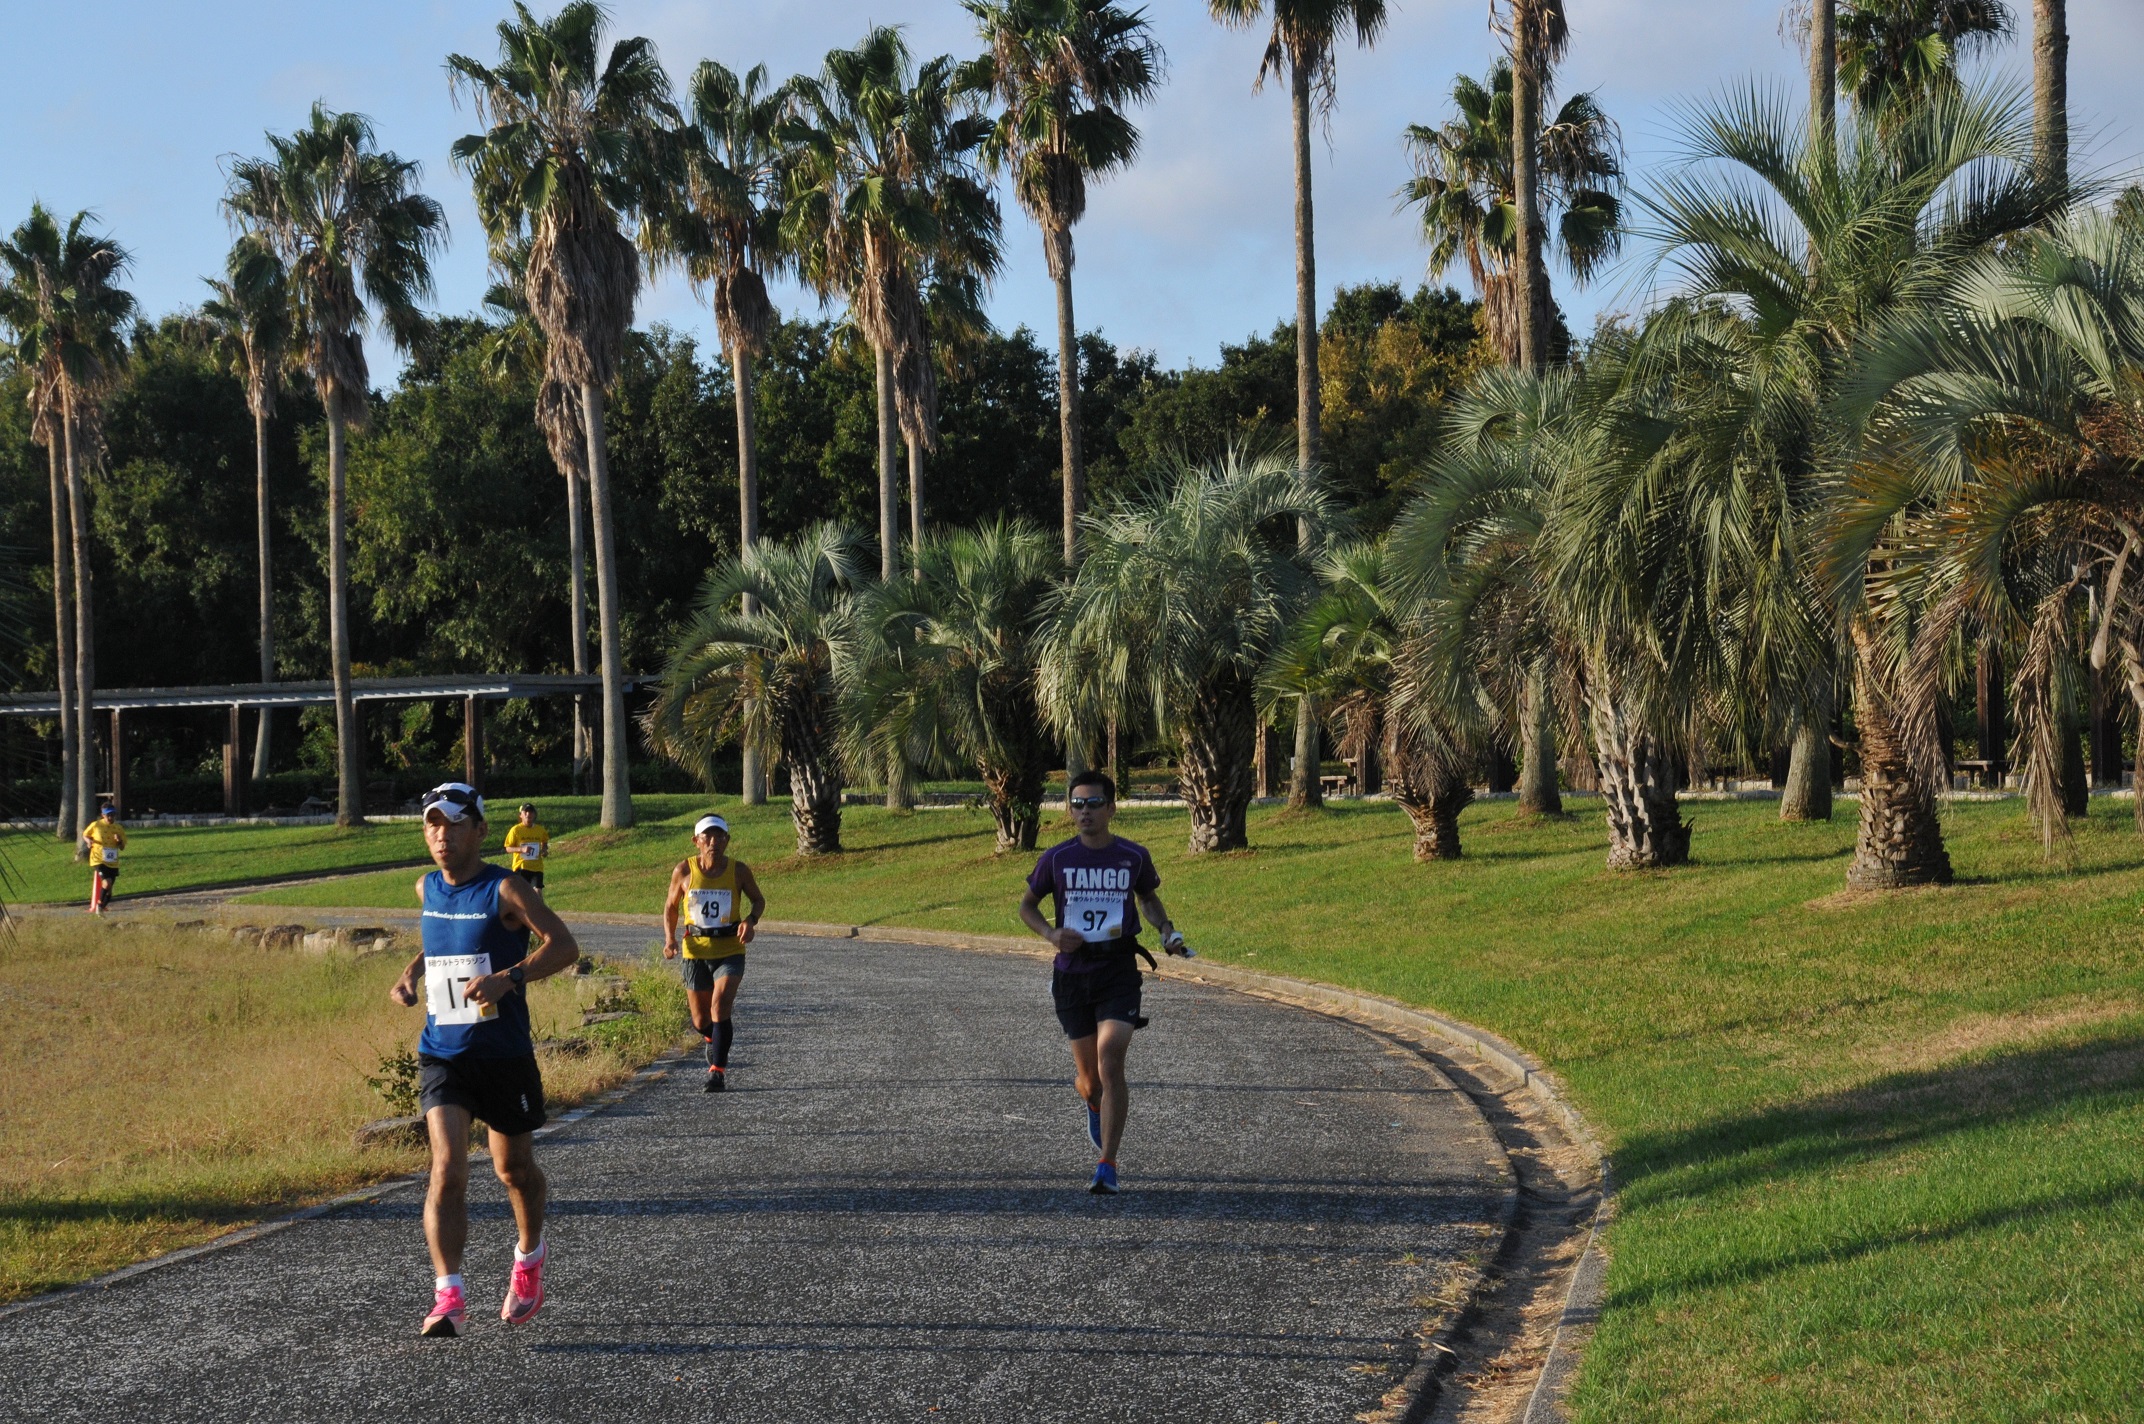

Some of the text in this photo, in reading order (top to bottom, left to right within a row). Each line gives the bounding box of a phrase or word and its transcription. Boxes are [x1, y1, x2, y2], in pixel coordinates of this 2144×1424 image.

[1063, 867, 1130, 890] TANGO
[701, 901, 720, 918] 49
[1082, 910, 1108, 931] 97
[447, 977, 471, 1009] 17
